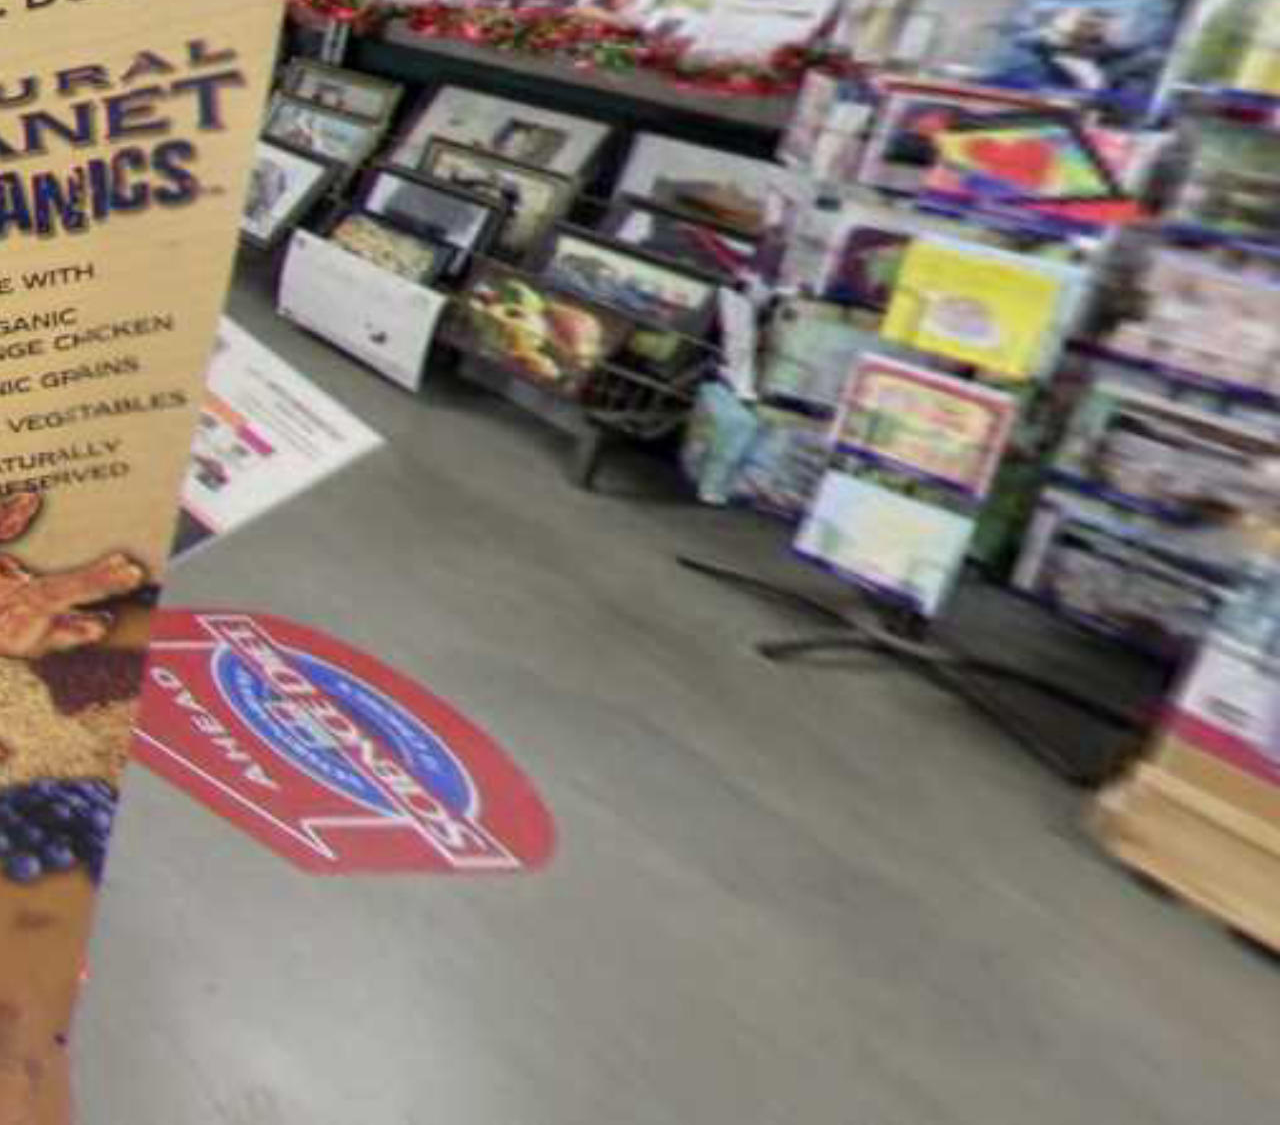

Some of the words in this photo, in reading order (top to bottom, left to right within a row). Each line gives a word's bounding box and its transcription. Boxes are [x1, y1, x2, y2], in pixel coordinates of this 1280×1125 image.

[21, 263, 97, 291] WITH
[52, 313, 176, 353] CHICKEN
[40, 355, 141, 390] GRAINS
[7, 388, 188, 433] VEGETABLES
[150, 665, 281, 791] AHEAD
